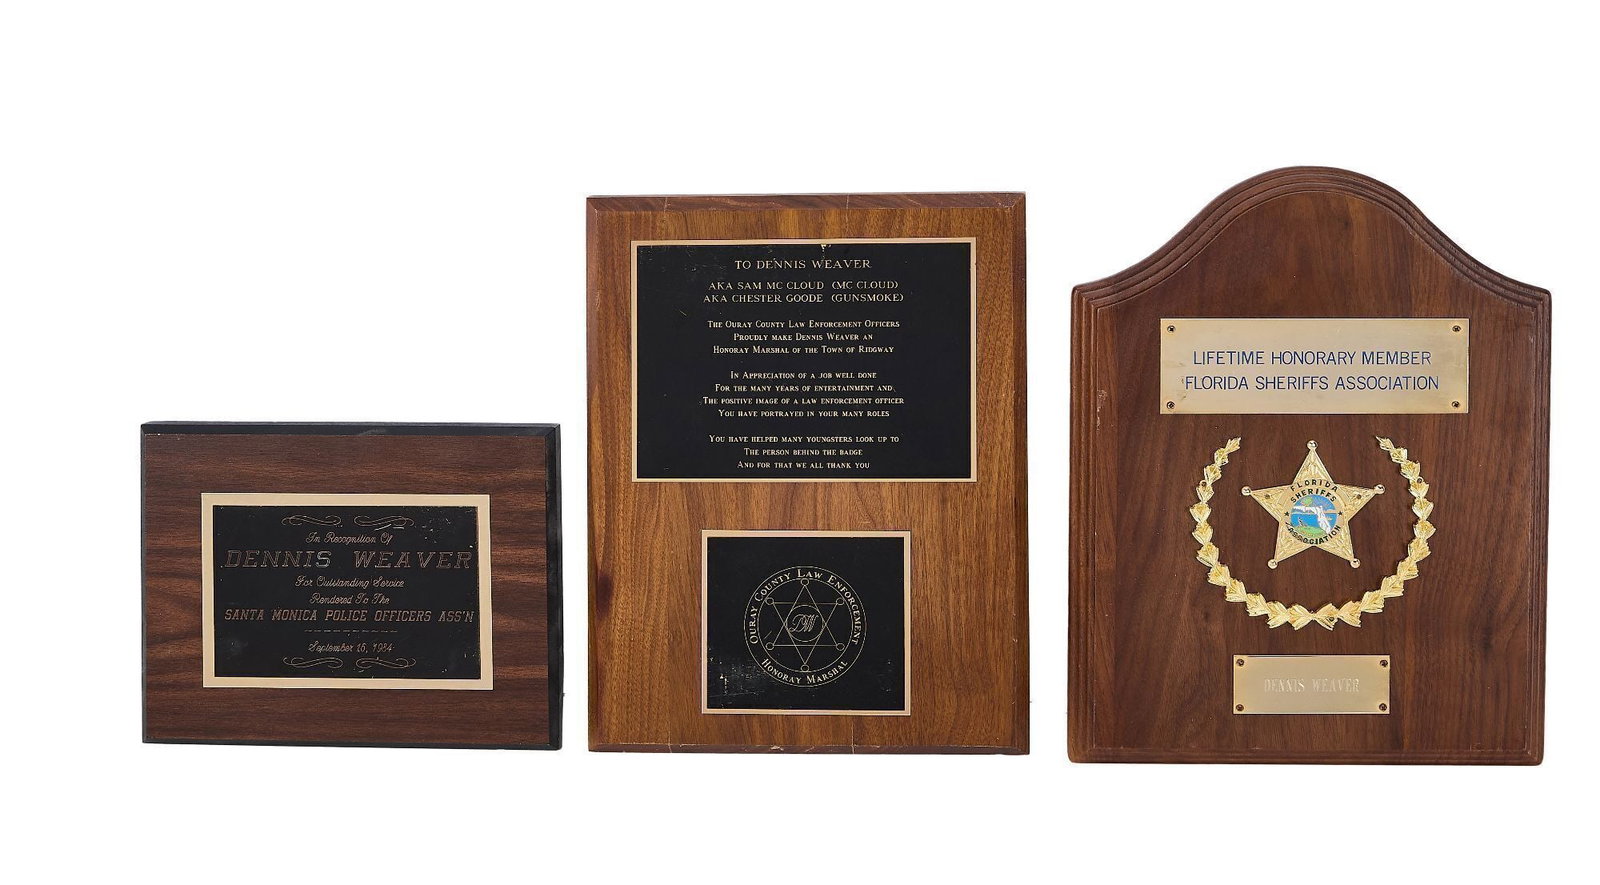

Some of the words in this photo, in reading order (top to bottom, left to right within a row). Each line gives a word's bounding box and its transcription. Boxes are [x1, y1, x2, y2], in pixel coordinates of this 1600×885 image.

[735, 260, 751, 270] TO
[757, 260, 806, 270] DENNIS
[812, 260, 871, 270] WEAVER
[708, 281, 733, 290] AKA
[737, 281, 761, 290] SAM
[766, 281, 783, 290] MC
[787, 281, 824, 290] CLOUD
[832, 281, 853, 290] (MC
[856, 281, 899, 290] CLOUD)
[703, 294, 728, 303] AKA
[732, 294, 782, 303] CHESTER
[786, 294, 823, 303] GOODE
[831, 294, 904, 303] (GUNSMOKE)
[708, 320, 722, 328] THE
[725, 320, 752, 328] OURAY
[756, 320, 785, 328] COUNTY
[788, 320, 805, 328] LAW
[809, 320, 861, 328] ENFORCEMENT
[865, 320, 900, 328] OFFICERS
[733, 333, 768, 341] PROUDLY
[771, 333, 792, 341] MAKE
[796, 333, 823, 341] DENNIS
[826, 333, 859, 341] WEAVER
[862, 333, 873, 341] AN
[713, 346, 749, 354] HONORAY
[753, 346, 789, 354] MARSHAL
[792, 346, 801, 354] OF
[805, 346, 818, 354] THE
[821, 346, 842, 354] TOWN
[846, 346, 855, 354] OF
[859, 346, 894, 354] RIDGWAY
[1193, 351, 1264, 365] LIFETIME
[1272, 351, 1356, 365] HONORARY
[1362, 351, 1431, 365] MEMBER
[730, 371, 739, 379] IN
[743, 371, 795, 379] APPRECIATION
[798, 371, 807, 379] OF
[810, 371, 816, 379] A
[819, 371, 832, 379] JOB
[835, 371, 855, 379] WELL
[858, 371, 877, 379] DONE
[715, 384, 730, 392] FOR
[733, 384, 747, 392] THE
[750, 384, 772, 392] MANY
[775, 384, 799, 392] YEARS
[802, 384, 811, 392] OF
[814, 384, 874, 392] ENTERTAINMENT
[877, 384, 893, 392] AND
[1185, 376, 1248, 390] FLORIDA
[1256, 376, 1328, 390] SHERIFFS
[1335, 376, 1439, 390] ASSOCIATION
[718, 409, 735, 417] YOU
[738, 409, 758, 417] HAVE
[761, 409, 804, 417] PORTRAYED
[807, 409, 815, 417] IN
[819, 409, 839, 417] YOUR
[842, 409, 864, 417] MANY
[867, 409, 890, 417] ROLES
[709, 435, 725, 443] YOU
[728, 435, 748, 443] HAVE
[751, 435, 778, 443] HELPED
[781, 435, 803, 443] MANY
[806, 435, 853, 443] YOUNGSTERS
[856, 435, 875, 443] LOOK
[878, 435, 887, 443] UP
[890, 435, 900, 443] TO
[744, 448, 759, 456] THE
[762, 448, 790, 456] PERSON
[793, 448, 820, 456] BEHIND
[823, 448, 837, 456] THE
[840, 448, 863, 456] BADGE
[737, 461, 754, 469] AND
[757, 461, 771, 469] FOR
[774, 461, 793, 469] THAT
[796, 461, 807, 469] WE
[810, 461, 824, 469] ALL
[827, 461, 851, 469] THANK
[855, 461, 870, 469] YOU
[1290, 479, 1338, 492] FLORIDA
[1290, 488, 1337, 503] SHERIFFS
[305, 531, 321, 543] In
[324, 531, 376, 544] Recognition
[380, 532, 393, 544] Of
[224, 550, 332, 568] DENNIS
[353, 550, 472, 568] WEAVER
[295, 576, 313, 587] For
[316, 576, 369, 589] Outstanding
[372, 576, 405, 587] Service
[309, 593, 353, 604] Rendered
[355, 593, 370, 604] To
[371, 593, 389, 604] The
[750, 606, 759, 644] OURAY
[755, 572, 791, 602] COUNTY
[797, 569, 823, 578] LAW
[827, 575, 862, 645] ENFORCEMENT
[224, 609, 264, 621] SANTA
[271, 610, 317, 621] MONICA
[325, 610, 366, 622] POLICE
[374, 610, 431, 622] OFFICERS
[438, 611, 474, 623] ASS'N
[308, 640, 353, 653] September
[761, 658, 801, 684] HONORAY
[807, 661, 848, 684] MARSHAL
[1264, 678, 1304, 692] DENNIS
[1312, 678, 1359, 692] WEAVER
